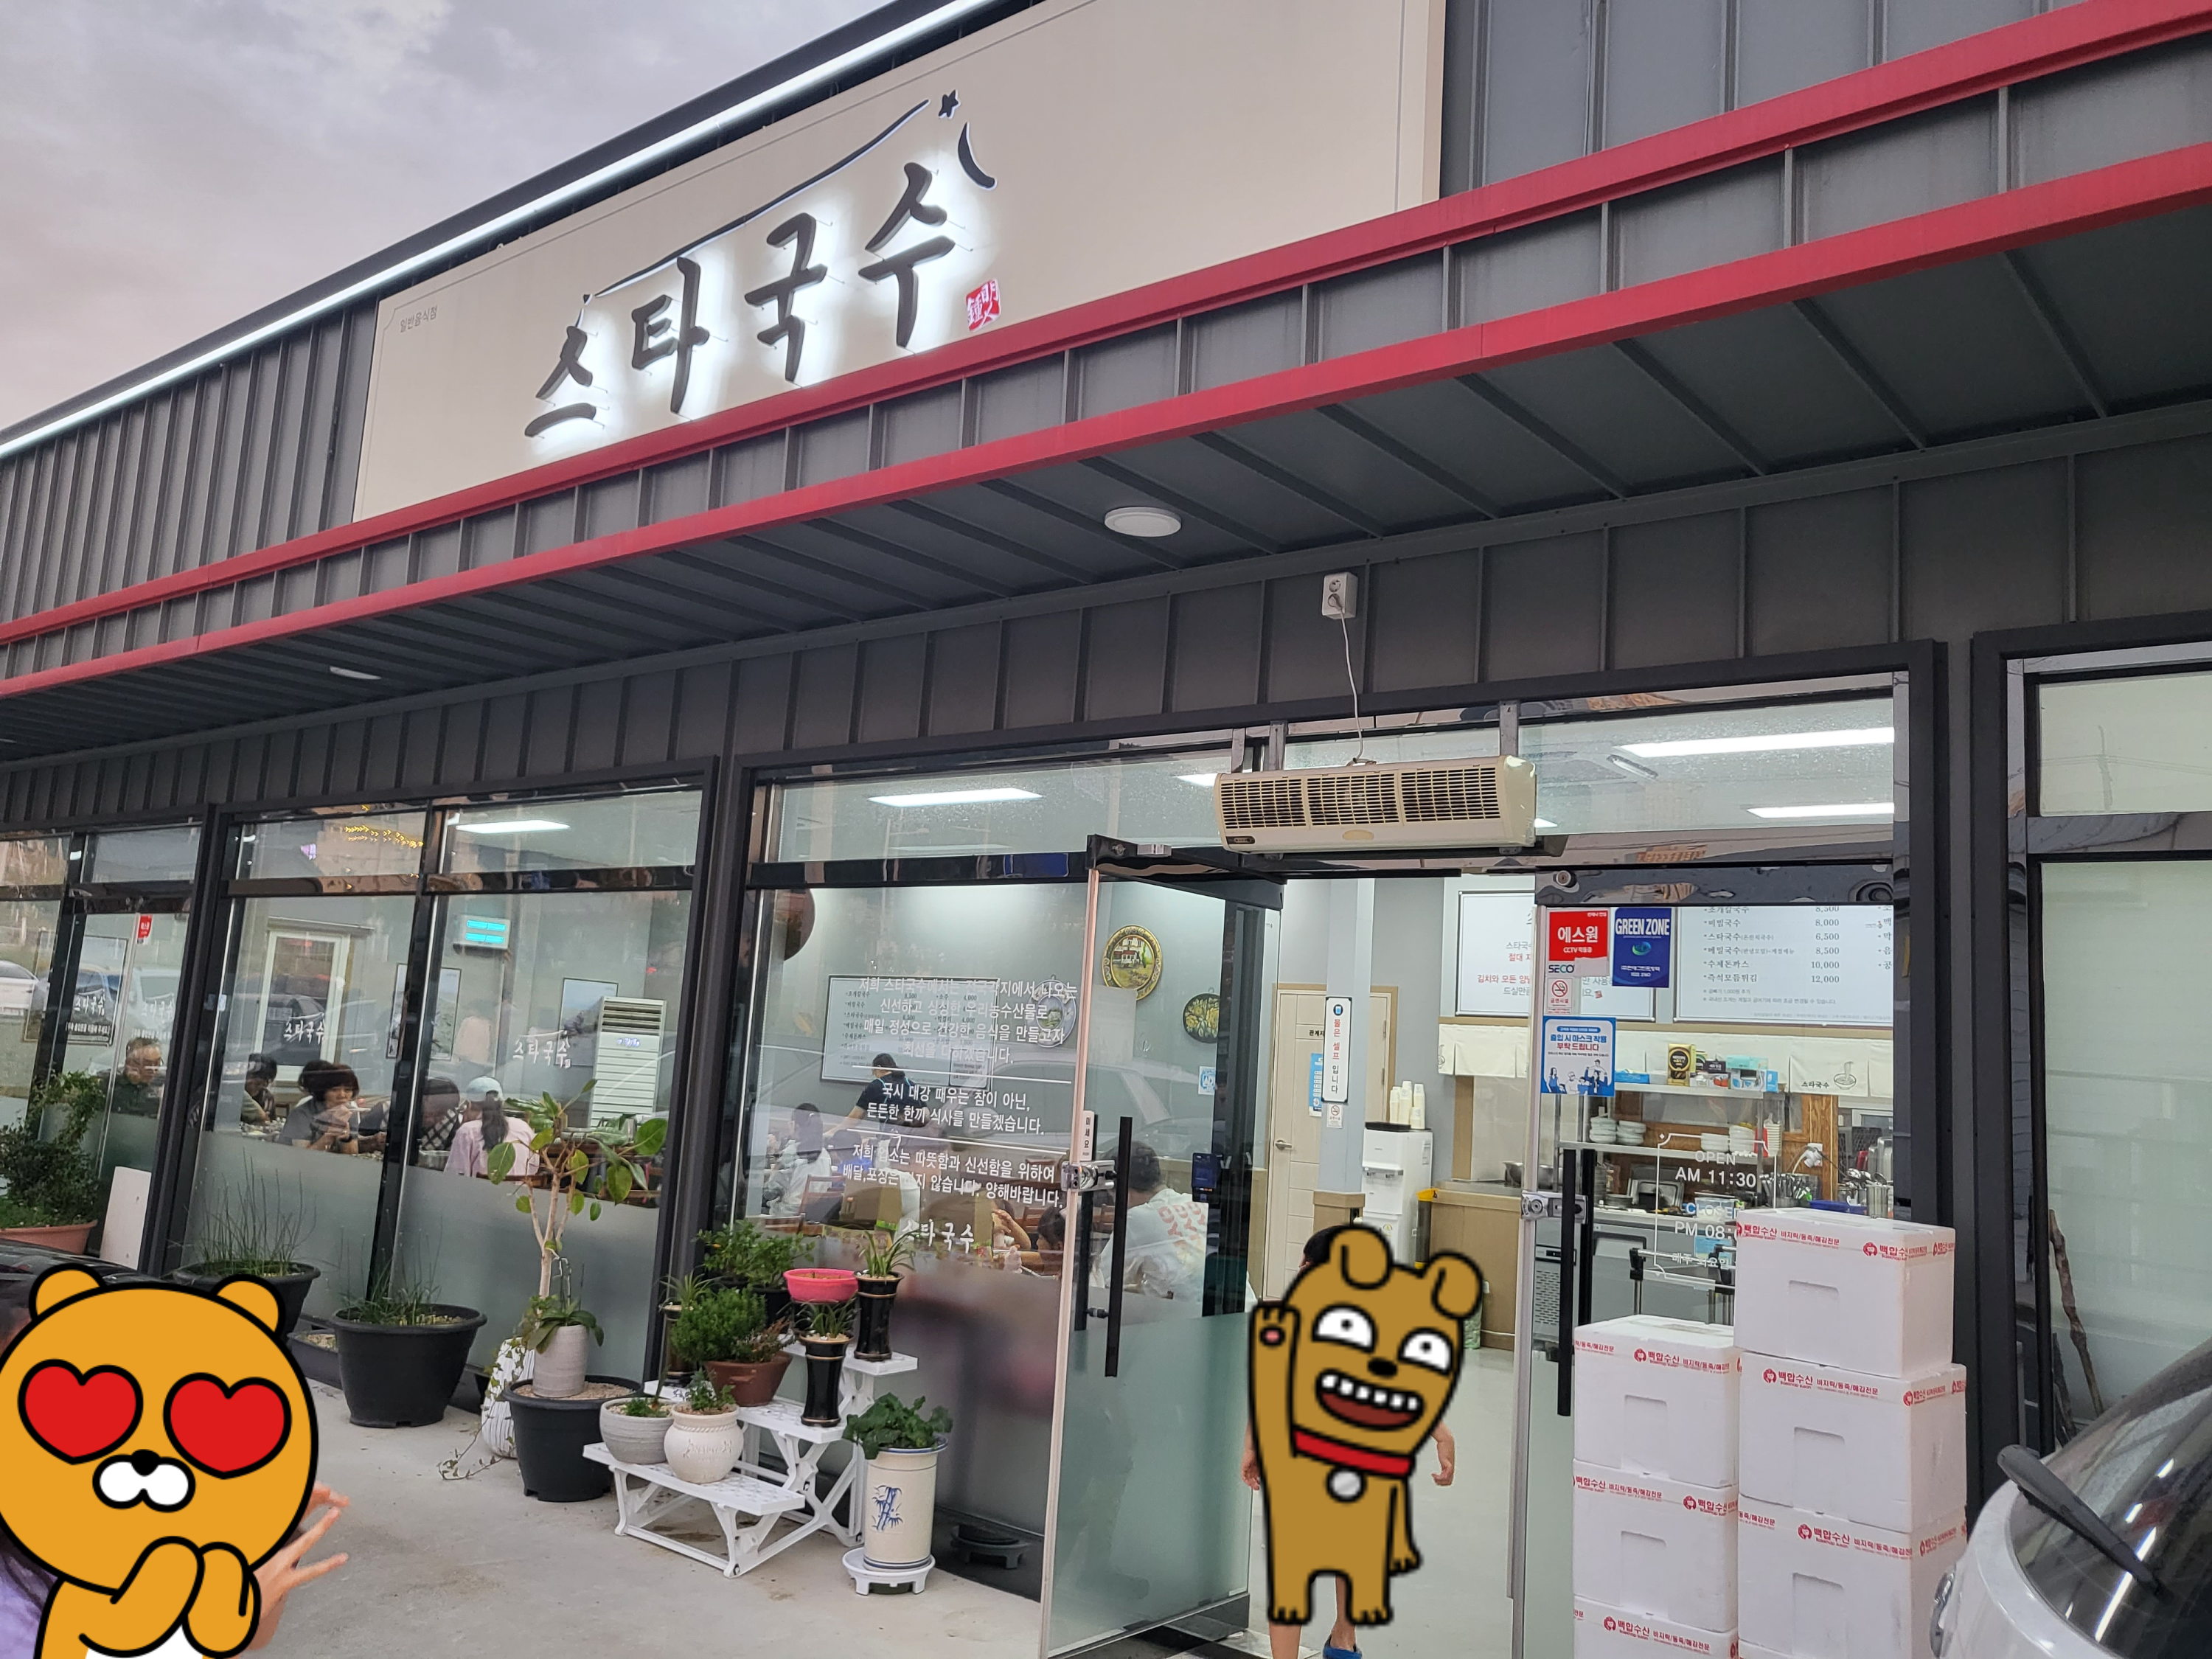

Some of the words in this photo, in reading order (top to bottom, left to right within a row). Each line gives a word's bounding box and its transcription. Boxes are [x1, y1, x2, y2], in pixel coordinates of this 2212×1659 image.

[524, 161, 956, 438] 스타국수
[400, 305, 438, 333] 일반음식점
[1615, 918, 1645, 935] GREEN
[1645, 918, 1670, 936] ZONE
[1708, 919, 1741, 928] 비빔국수
[1815, 919, 1840, 927] 8,000
[1557, 925, 1599, 943] 에스원
[1815, 933, 1840, 941] 6,500
[1509, 953, 1523, 961] 절대
[1815, 947, 1840, 955] 8,500
[1548, 964, 1575, 973] SECO
[1707, 960, 1750, 969] 수제돈까스
[1811, 961, 1840, 970] 10,000
[859, 977, 880, 993] 저희
[883, 978, 962, 995] 스타국수에서는
[1040, 981, 1078, 999] 나오는
[1477, 974, 1499, 984] 김치와
[1501, 975, 1517, 984] 모든
[1707, 973, 1758, 983] 즉석모듬튀김
[1811, 975, 1840, 984] 12,000
[75, 995, 105, 1016] 스타국수
[880, 998, 922, 1016] 신선하고
[928, 999, 961, 1017] 싱싱한
[965, 1001, 1048, 1020] 우리농수산물로
[283, 1020, 325, 1046] 스타국수
[863, 1018, 885, 1034] 매일
[888, 1019, 932, 1036] 정성으로
[936, 1020, 970, 1039] 건강한
[975, 1023, 1012, 1041] 음식을
[1015, 1025, 1065, 1045] 만들고자
[1334, 1018, 1341, 1037] 물은
[1550, 1034, 1564, 1042] 출입
[1564, 1034, 1572, 1042] 시
[1572, 1034, 1593, 1043] 마스크
[1571, 1043, 1599, 1051] 드립니다
[512, 1037, 568, 1068] 스타국수
[903, 1040, 936, 1059] 최선을
[941, 1043, 1014, 1064] 다하겠습니다.
[1332, 1042, 1340, 1060] 셀프
[1331, 1065, 1339, 1094] 입니다
[1801, 1081, 1830, 1089] 스타국수
[882, 1082, 905, 1099] 국시
[908, 1084, 931, 1102] 대강
[935, 1086, 970, 1105] 때우는
[973, 1088, 998, 1108] 참이
[1002, 1091, 1031, 1112] 아닌,
[866, 1102, 900, 1120] 든든한
[903, 1105, 926, 1124] 한끼
[929, 1107, 965, 1127] 식사를
[969, 1110, 1045, 1135] 만들겠습니다.
[1083, 1116, 1091, 1149] 미세요
[852, 1144, 874, 1161] 저희
[914, 1150, 961, 1172] 따뜻함과
[964, 1155, 1013, 1178] 신선함을
[1017, 1161, 1056, 1183] 위하여
[1695, 1150, 1736, 1166] OPEN
[1675, 1166, 1700, 1183] AM
[1708, 1169, 1756, 1188] 11:30
[930, 1173, 980, 1197] 않습니다.
[984, 1181, 1064, 1209] 양해바랍니다.
[1674, 1221, 1698, 1237] PM
[1705, 1224, 1737, 1242] 08:
[1744, 1223, 1778, 1237] 백합수산
[1672, 1252, 1693, 1265] 매주
[1647, 1350, 1680, 1365] 백합수산
[1778, 1371, 1813, 1385] 백합수산
[1816, 1378, 1879, 1396] 바지락/동죽/해감전문
[1575, 1475, 1606, 1489] 백합수산
[1814, 1526, 1851, 1545] 백합수산
[1618, 1619, 1650, 1638] 백합수산
